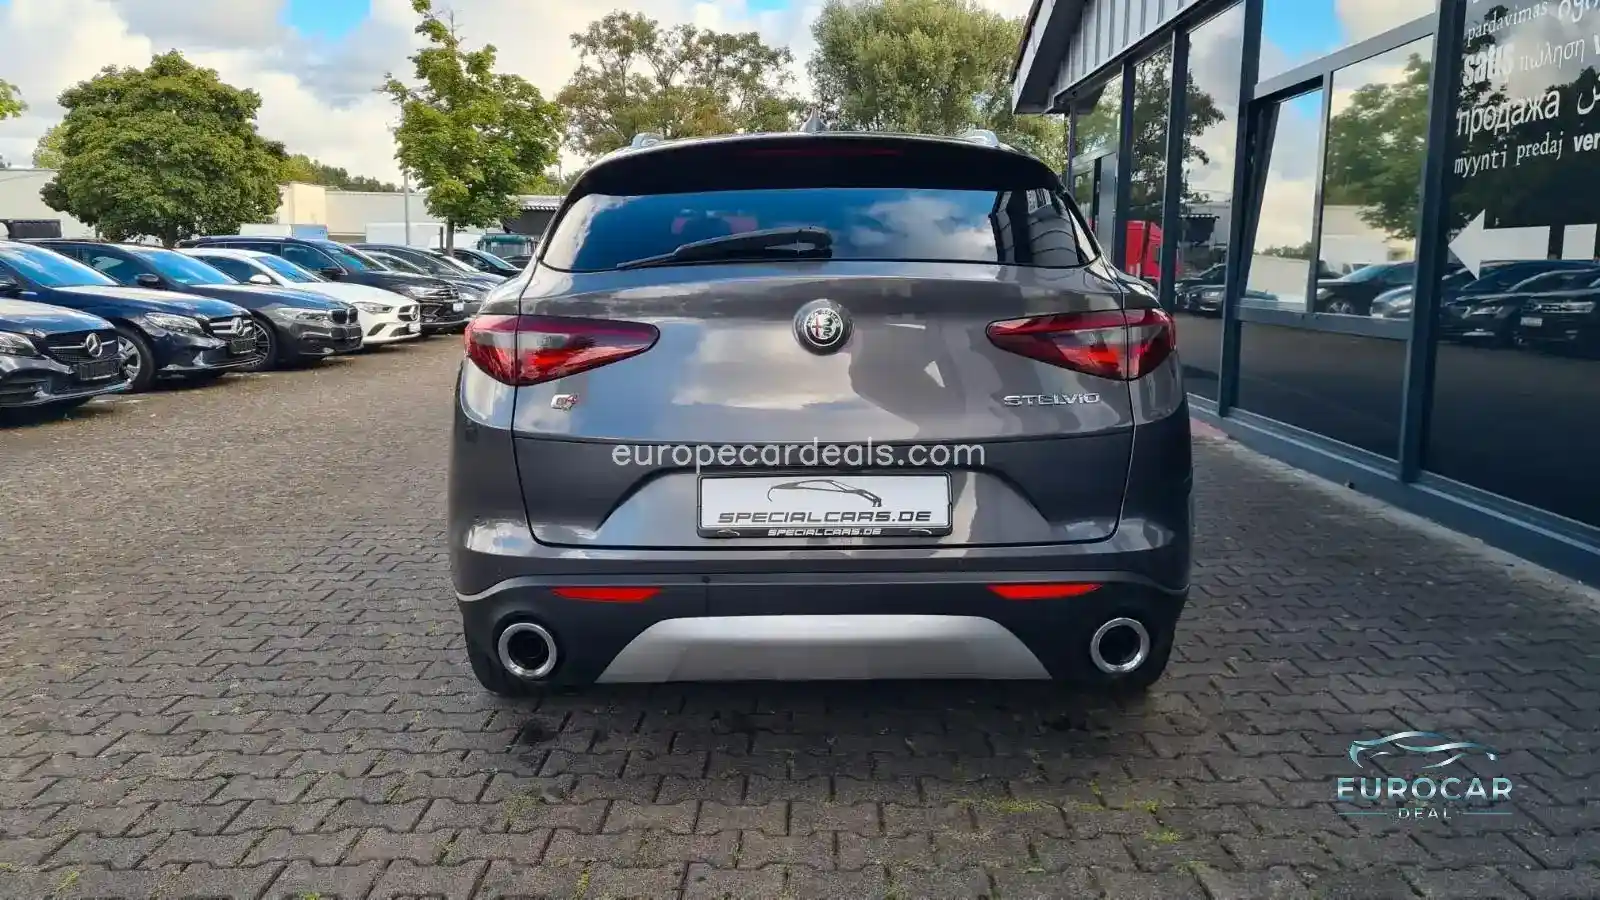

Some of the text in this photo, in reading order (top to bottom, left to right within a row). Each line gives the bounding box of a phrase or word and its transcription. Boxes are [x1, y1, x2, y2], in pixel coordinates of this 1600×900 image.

[1467, 1, 1549, 48] pardavimas
[1456, 89, 1561, 142] продажа
[1453, 144, 1508, 178] myynti
[1516, 130, 1564, 165] predaj
[1003, 392, 1100, 406] STELVIO
[717, 511, 932, 524] SPECIALCARS.DE
[767, 528, 882, 537] SPECIALCARS.DE
